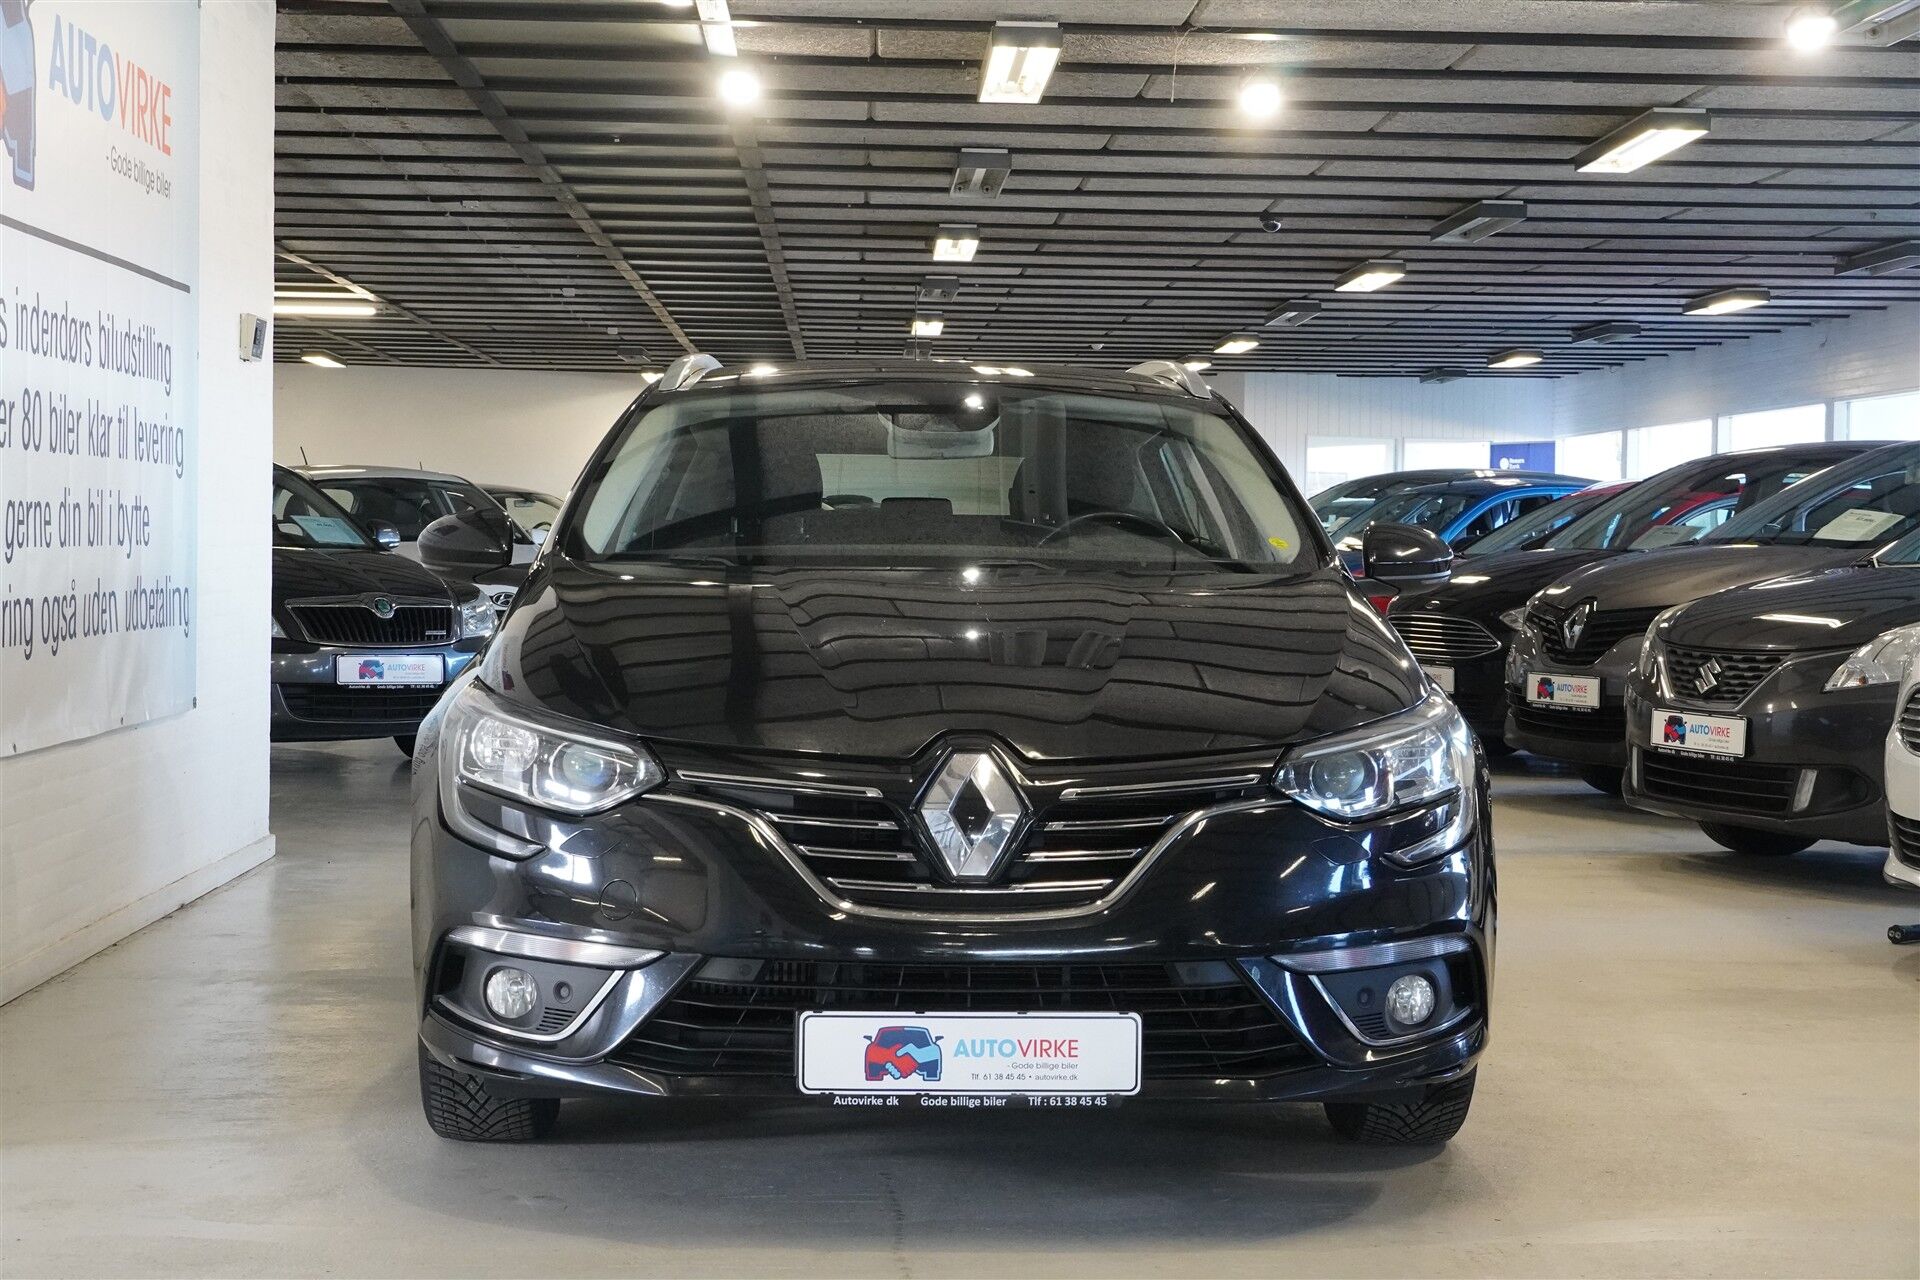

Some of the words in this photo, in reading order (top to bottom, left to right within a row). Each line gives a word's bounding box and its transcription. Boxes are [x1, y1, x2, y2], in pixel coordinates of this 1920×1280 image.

[48, 13, 171, 157] AUTOVIRKE
[110, 145, 132, 179] Gode
[133, 156, 155, 195] billige
[156, 169, 171, 200] biler
[15, 286, 92, 367] indendørs
[98, 310, 172, 397] biludstilling
[21, 387, 42, 452] 80
[49, 391, 82, 456] biler
[88, 398, 113, 459] klar
[118, 405, 128, 460] til
[134, 407, 184, 479] levering
[5, 499, 51, 564] gerne
[58, 487, 81, 548] din
[87, 488, 104, 548] bil
[108, 490, 112, 547] i
[117, 490, 150, 559] bytte
[41, 578, 77, 657] også
[83, 578, 119, 638] uden
[125, 575, 190, 638] udbetaling
[387, 663, 426, 672] AUTOVIRKE
[1689, 725, 1730, 737] AUTOVIRKE
[953, 1038, 1079, 1058] AUTOVIRKE
[1011, 1062, 1034, 1070] Gode
[1035, 1062, 1059, 1071] billige
[1061, 1062, 1079, 1070] biler
[1034, 1073, 1079, 1081] autovirke.dk
[833, 1095, 883, 1107] Autovirke
[887, 1095, 900, 1106] dk
[920, 1096, 948, 1107] Gode
[951, 1095, 981, 1109] billige
[984, 1095, 1007, 1107] biler
[1049, 1096, 1062, 1106] 61
[1065, 1096, 1077, 1106] 38
[1080, 1096, 1092, 1106] 45
[1095, 1096, 1108, 1106] 45
